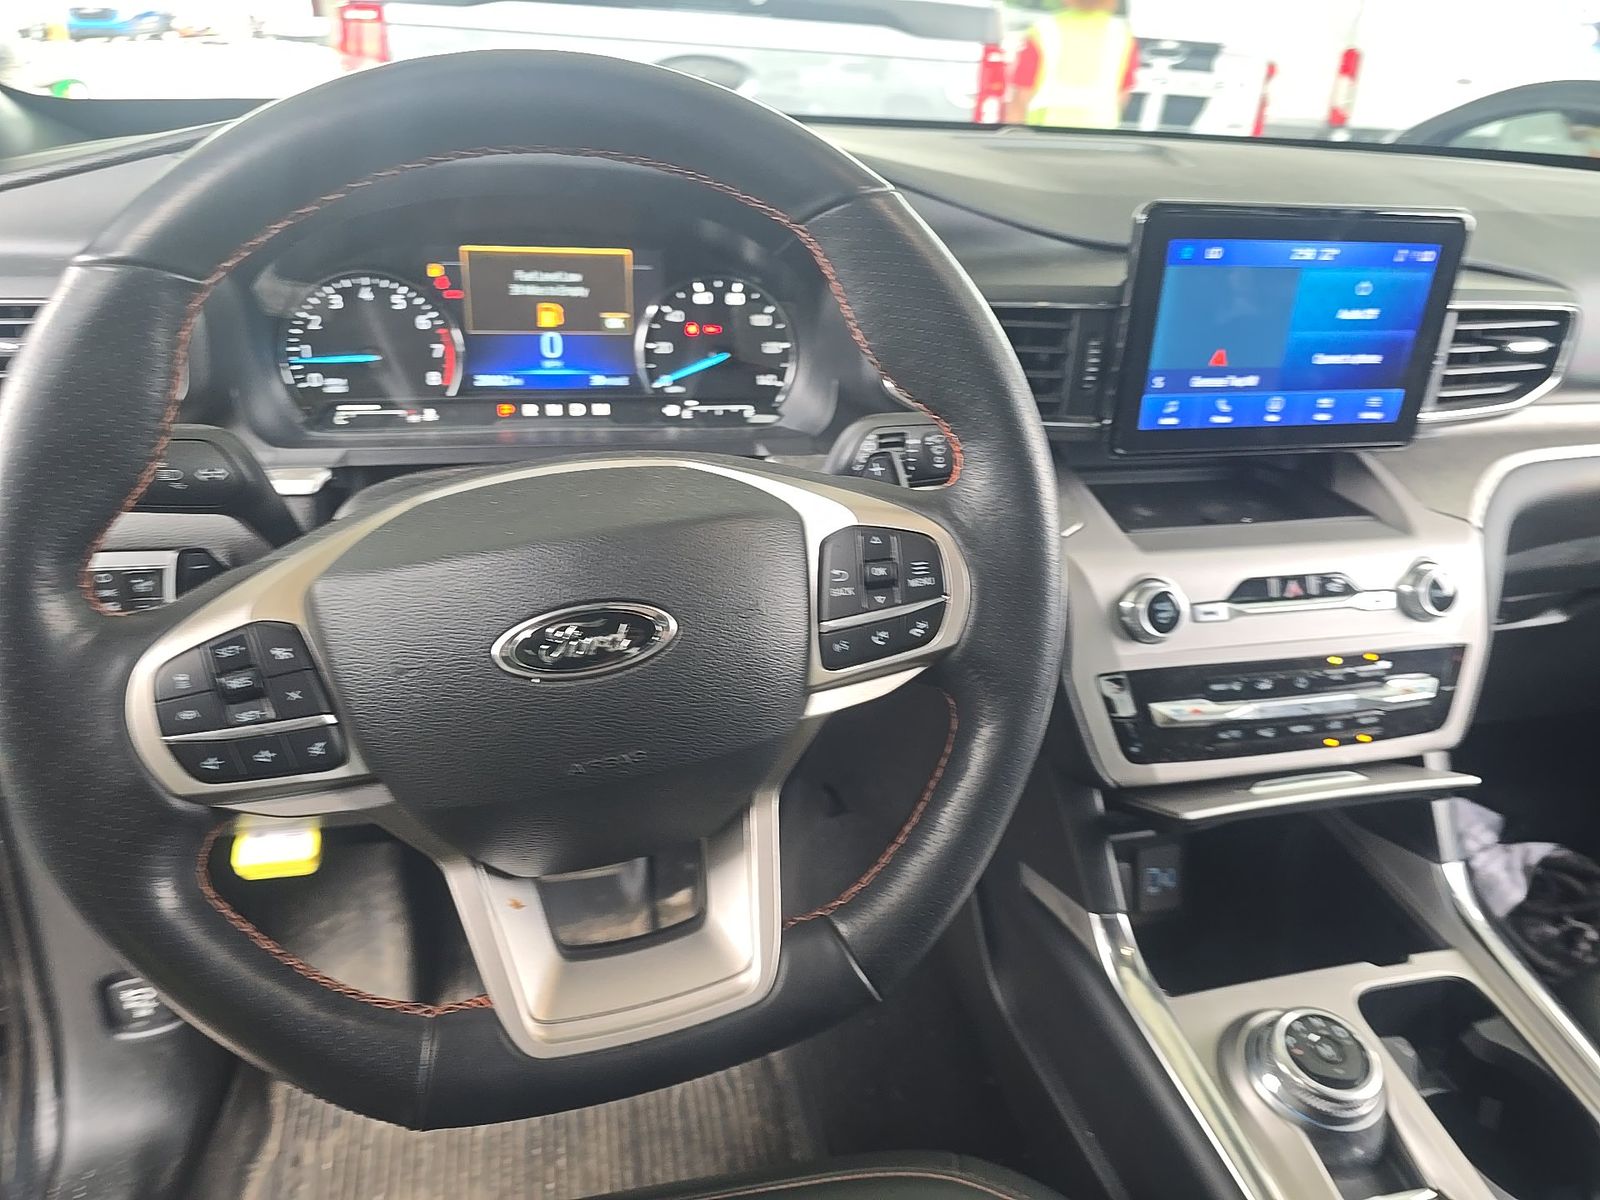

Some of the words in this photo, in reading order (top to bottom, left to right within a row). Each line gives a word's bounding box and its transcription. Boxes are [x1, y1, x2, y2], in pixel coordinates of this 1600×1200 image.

[327, 294, 344, 310] 3
[390, 294, 407, 310] 5
[306, 315, 323, 330] 2
[540, 331, 564, 359] 0
